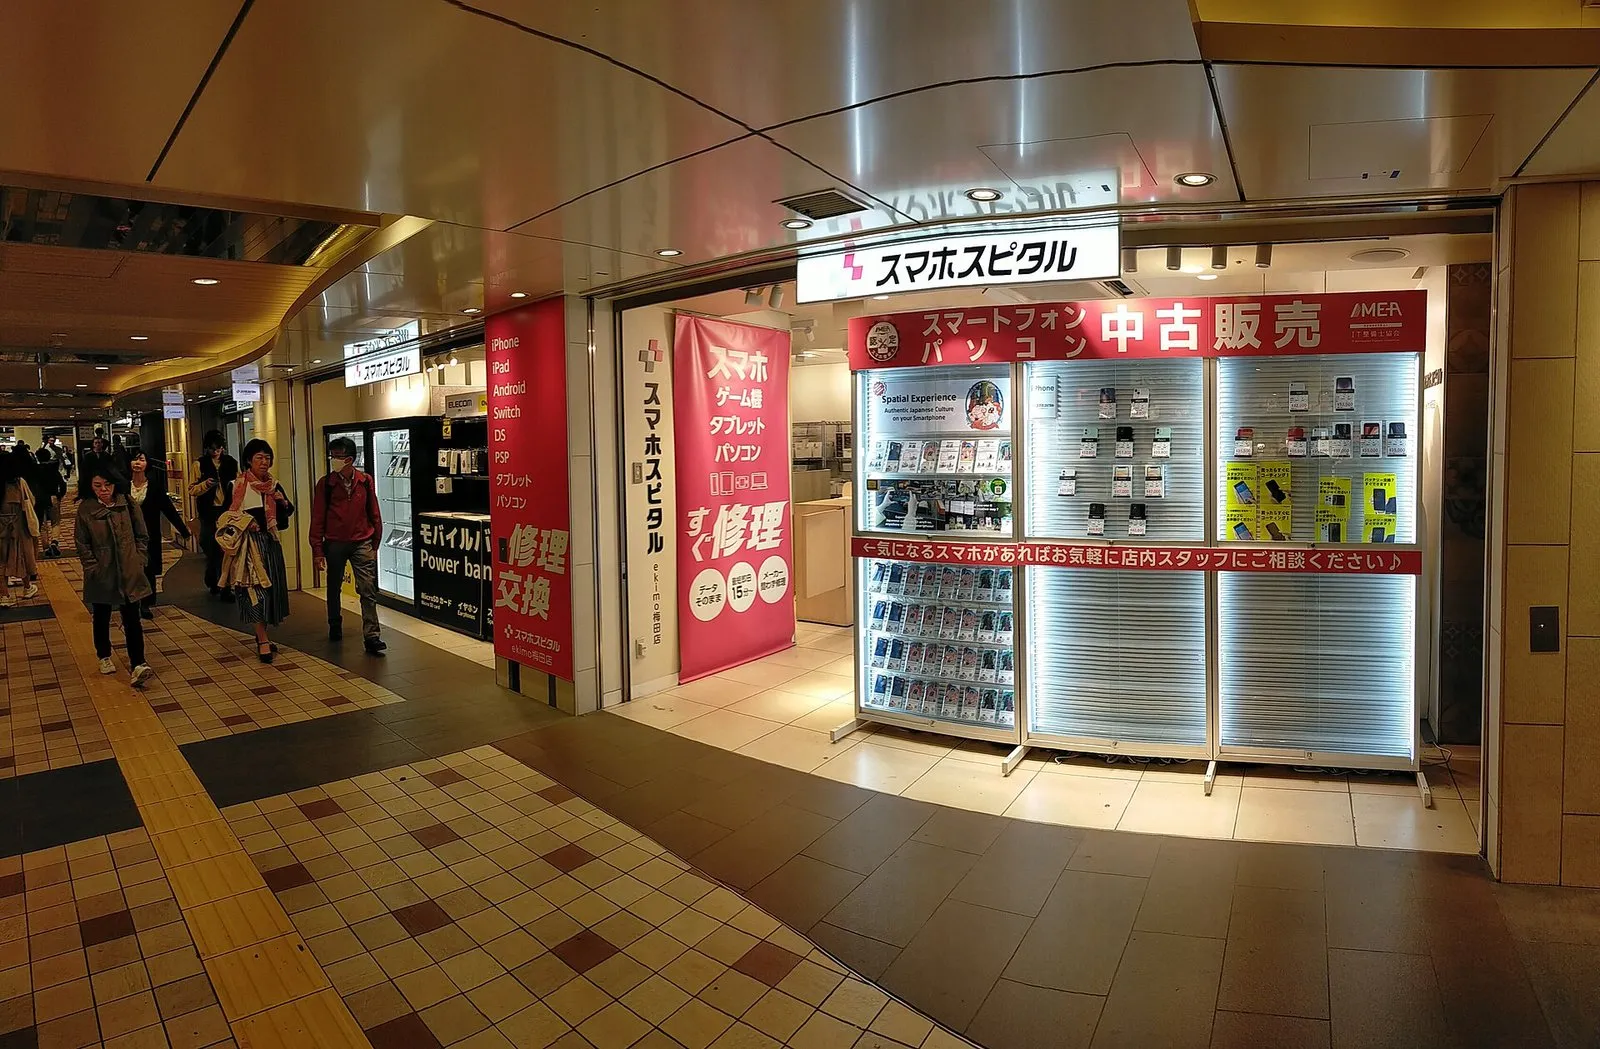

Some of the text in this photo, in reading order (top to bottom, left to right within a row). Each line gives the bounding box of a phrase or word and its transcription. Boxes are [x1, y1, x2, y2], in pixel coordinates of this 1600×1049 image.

[876, 240, 1077, 287] スマホスピタル
[922, 306, 1087, 337] スマートフォン
[1101, 300, 1322, 353] 中古販売
[491, 336, 520, 352] iPhone
[921, 337, 1087, 364] パソコン
[492, 358, 510, 375] iPad
[707, 345, 769, 383] スマホ
[493, 380, 526, 397] Android
[448, 399, 473, 409] ELECOM
[882, 393, 957, 405] Spatial Experience
[493, 404, 521, 419] Switch
[709, 415, 766, 435] タブレット
[494, 429, 506, 442] DS
[495, 451, 510, 464] PSP
[714, 442, 762, 463] パソコン
[644, 382, 664, 555] スマホスピタル
[496, 473, 532, 488] タブレット
[496, 494, 527, 509] パソコン
[711, 500, 789, 560] 修理
[508, 523, 569, 575] 修理
[420, 548, 460, 575] Power
[495, 570, 550, 621] 交換
[699, 583, 718, 596] データ
[695, 594, 722, 607] そのまま
[514, 629, 561, 652] スマホスピタル
